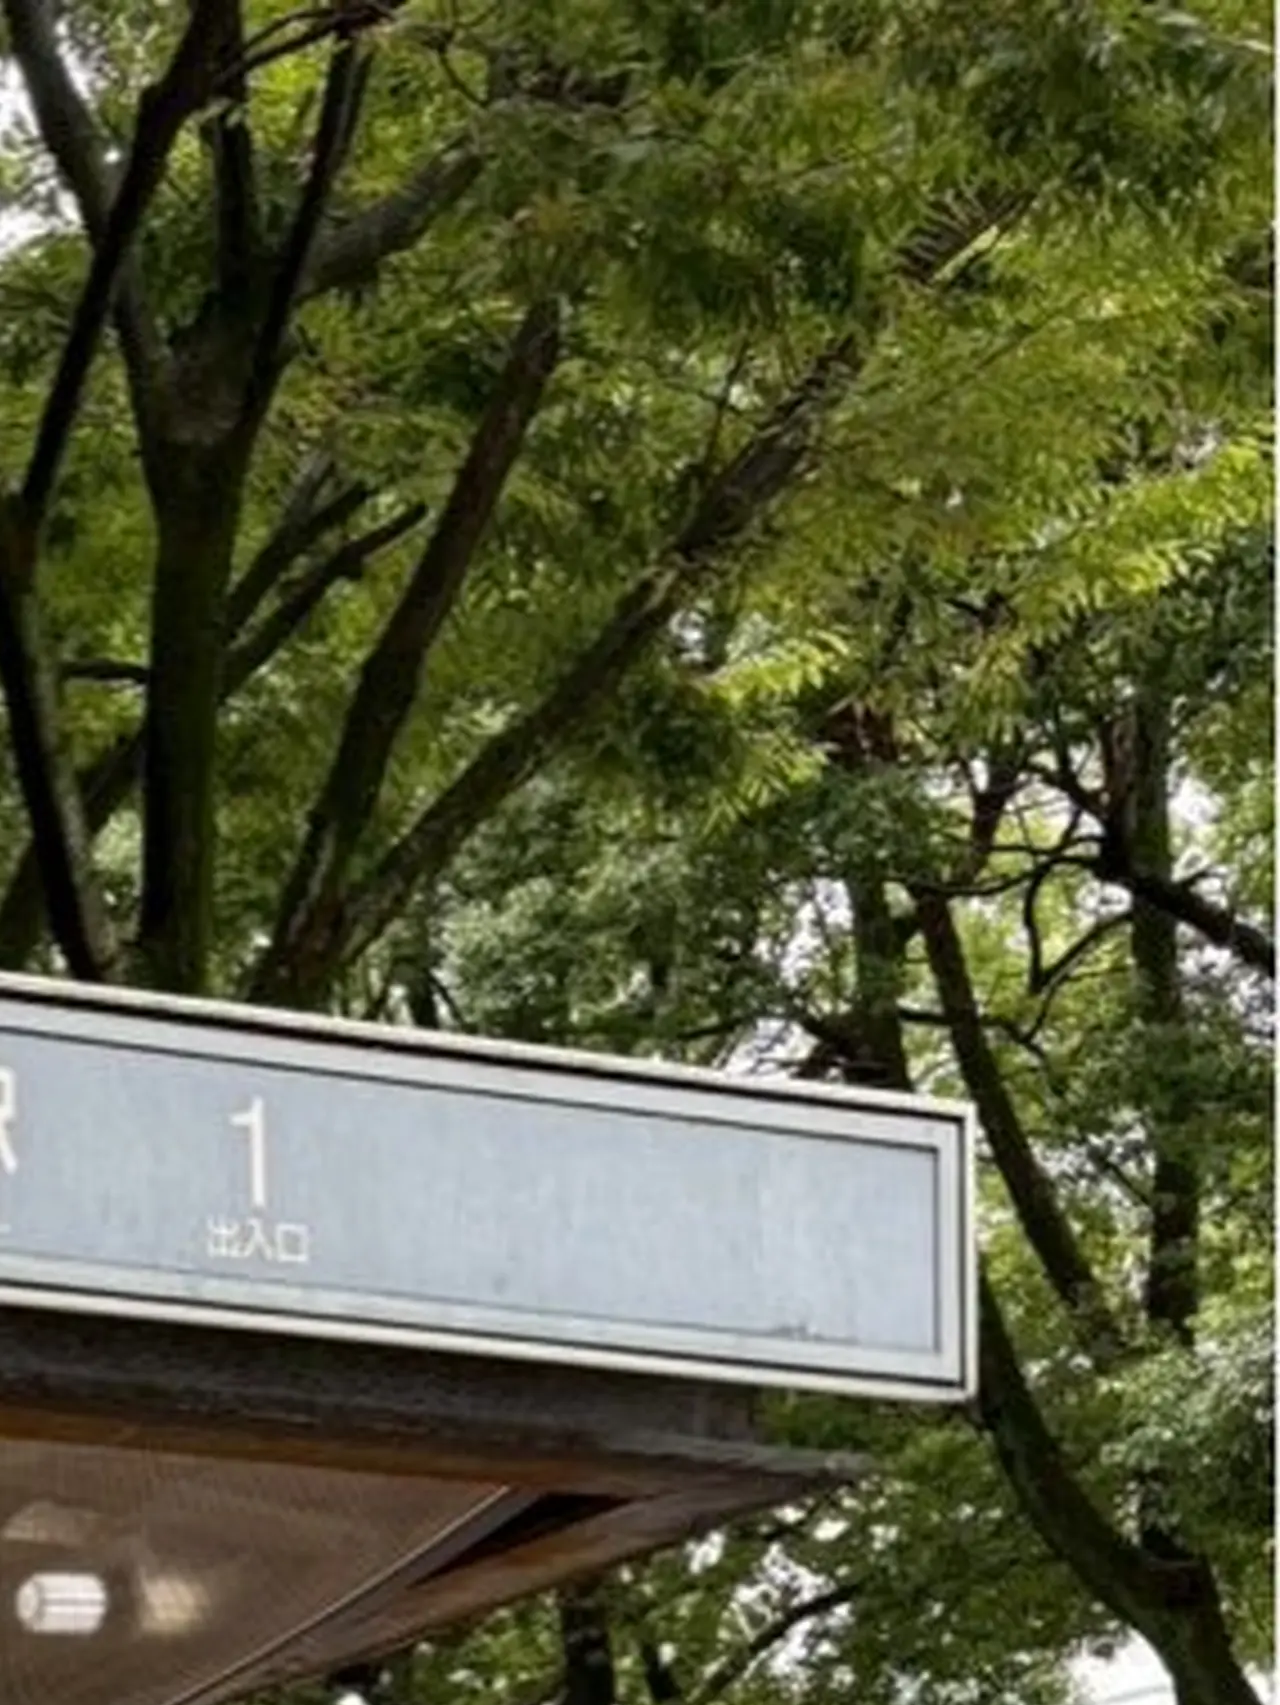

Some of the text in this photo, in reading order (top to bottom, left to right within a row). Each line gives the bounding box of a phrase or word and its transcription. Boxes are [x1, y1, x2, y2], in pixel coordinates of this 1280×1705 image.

[228, 1095, 266, 1207] 1
[206, 1215, 311, 1264] 出入口
